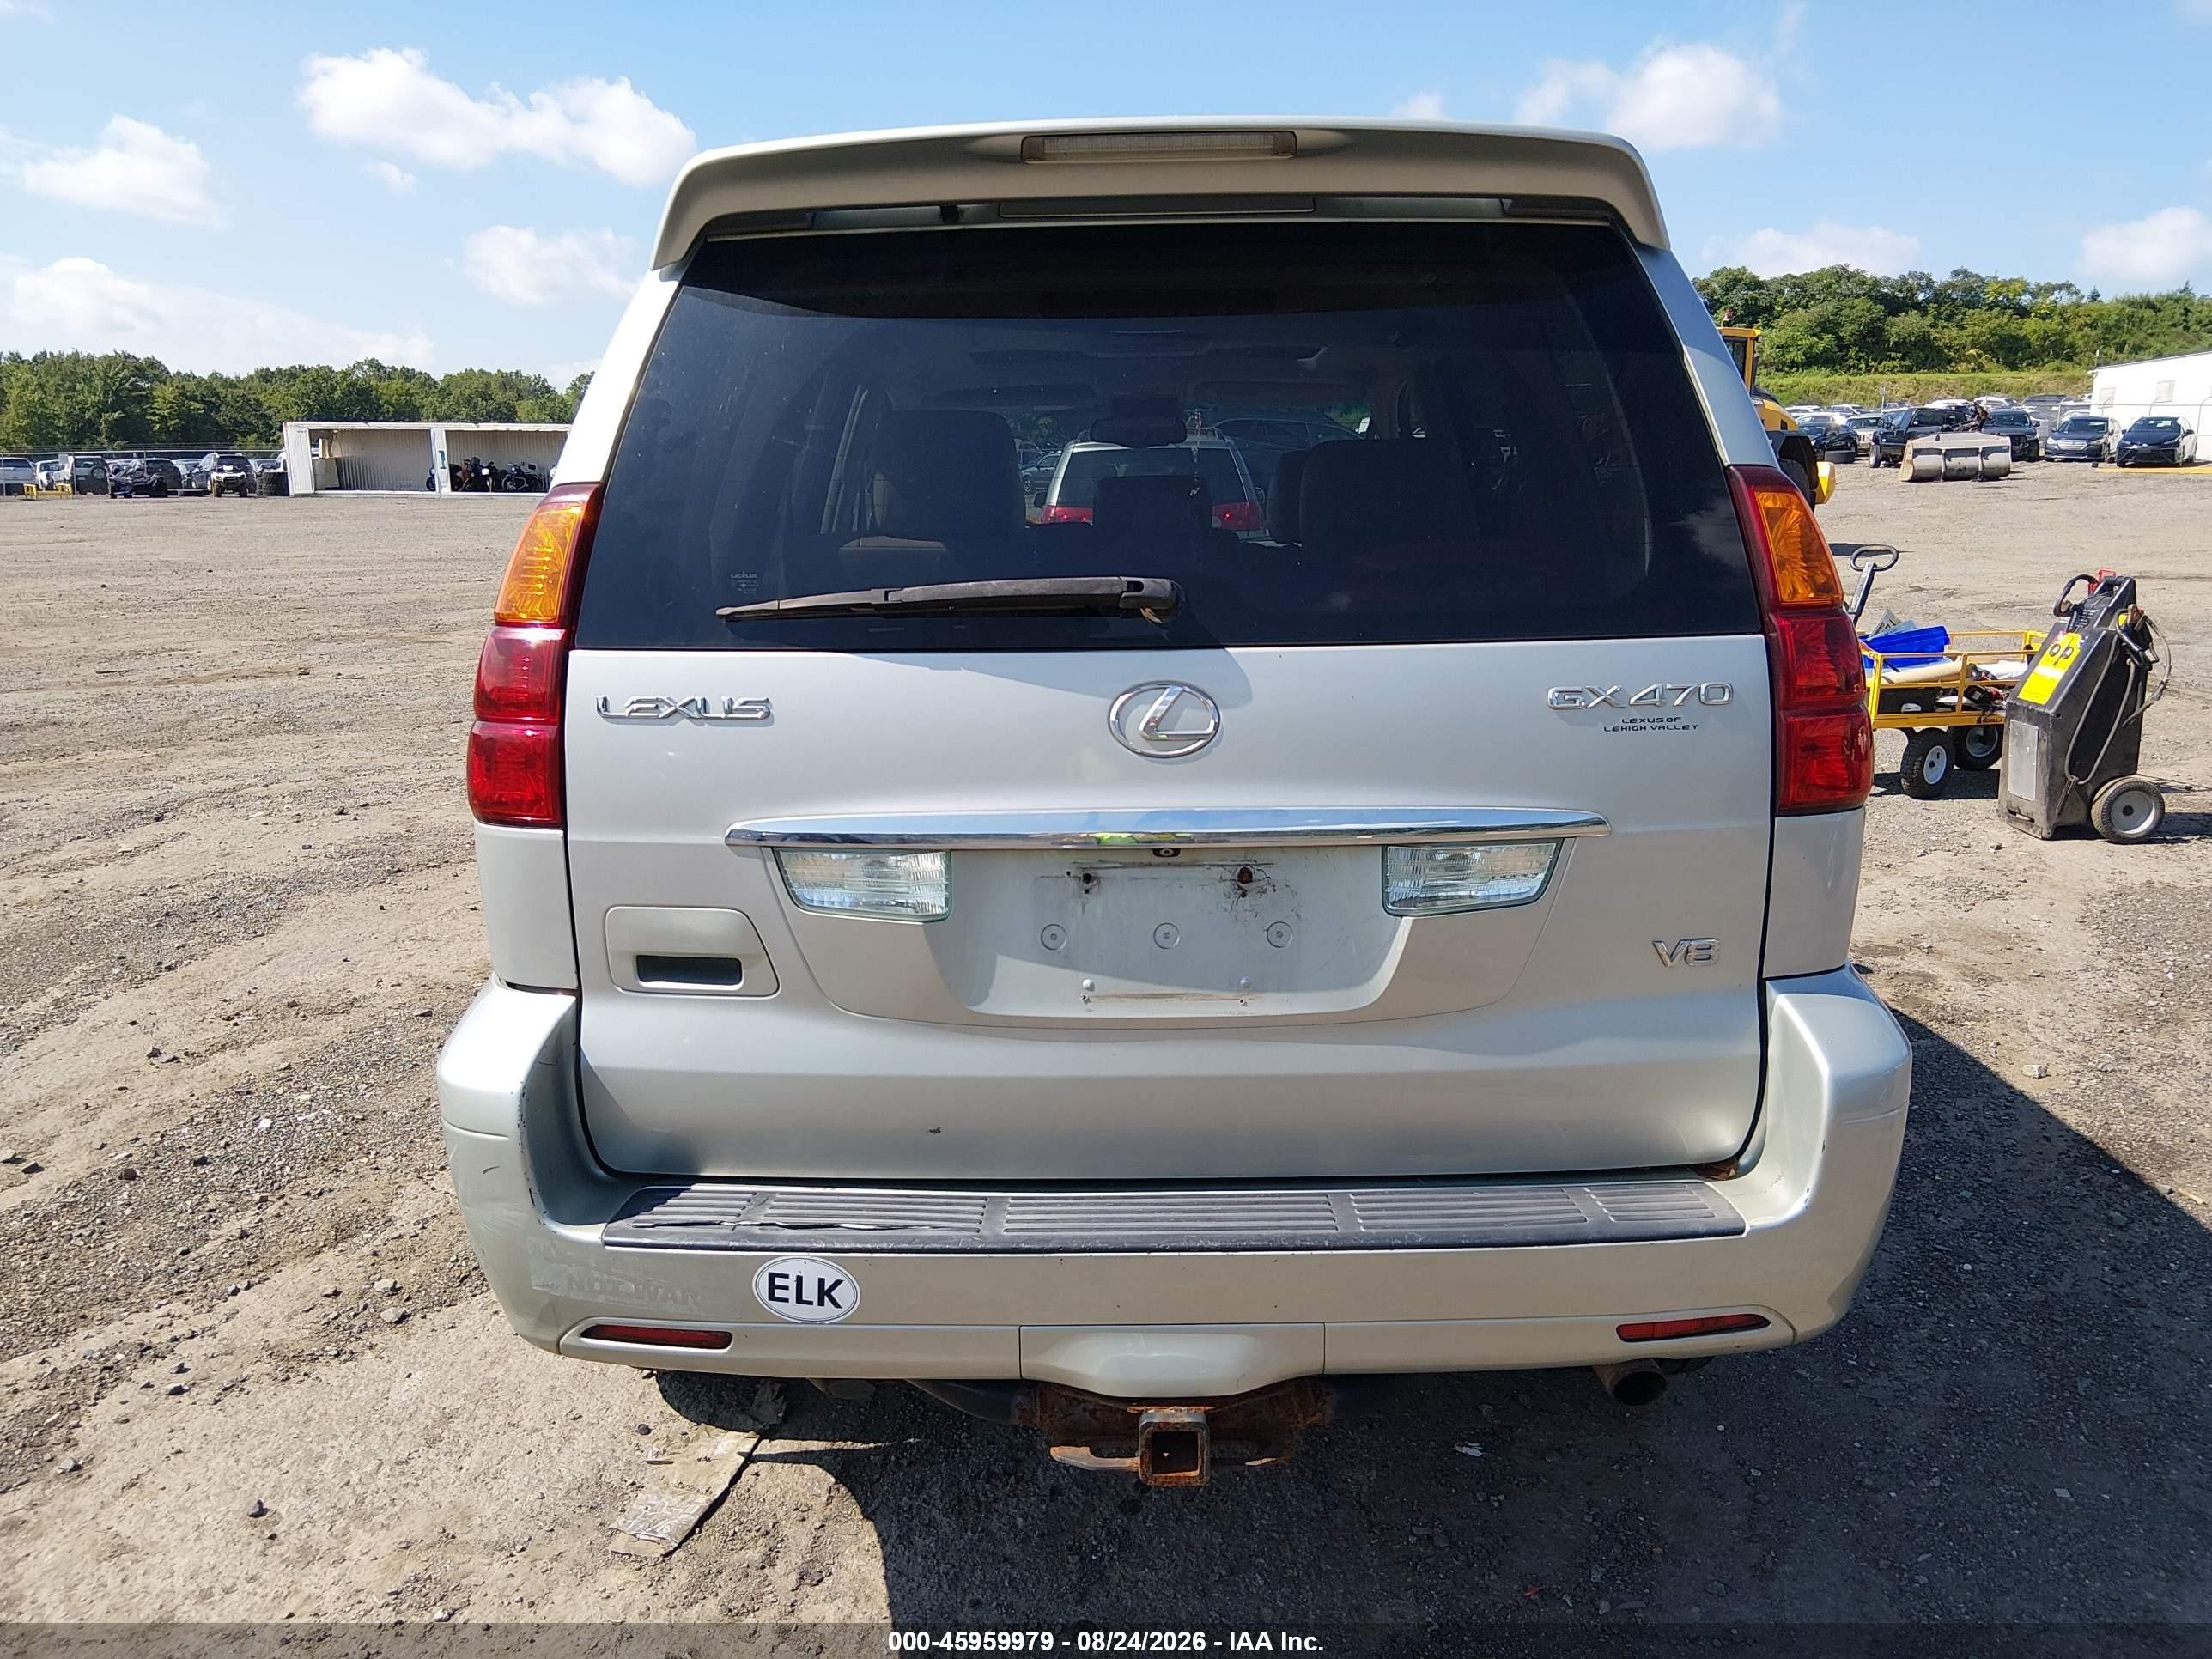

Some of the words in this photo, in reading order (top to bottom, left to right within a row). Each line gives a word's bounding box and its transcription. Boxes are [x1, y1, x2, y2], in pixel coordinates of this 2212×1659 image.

[596, 694, 772, 720] LEXUS
[1547, 684, 1626, 710] GX
[1628, 681, 1734, 708] 470
[1652, 937, 1722, 969] V8
[767, 1271, 844, 1310] ELK
